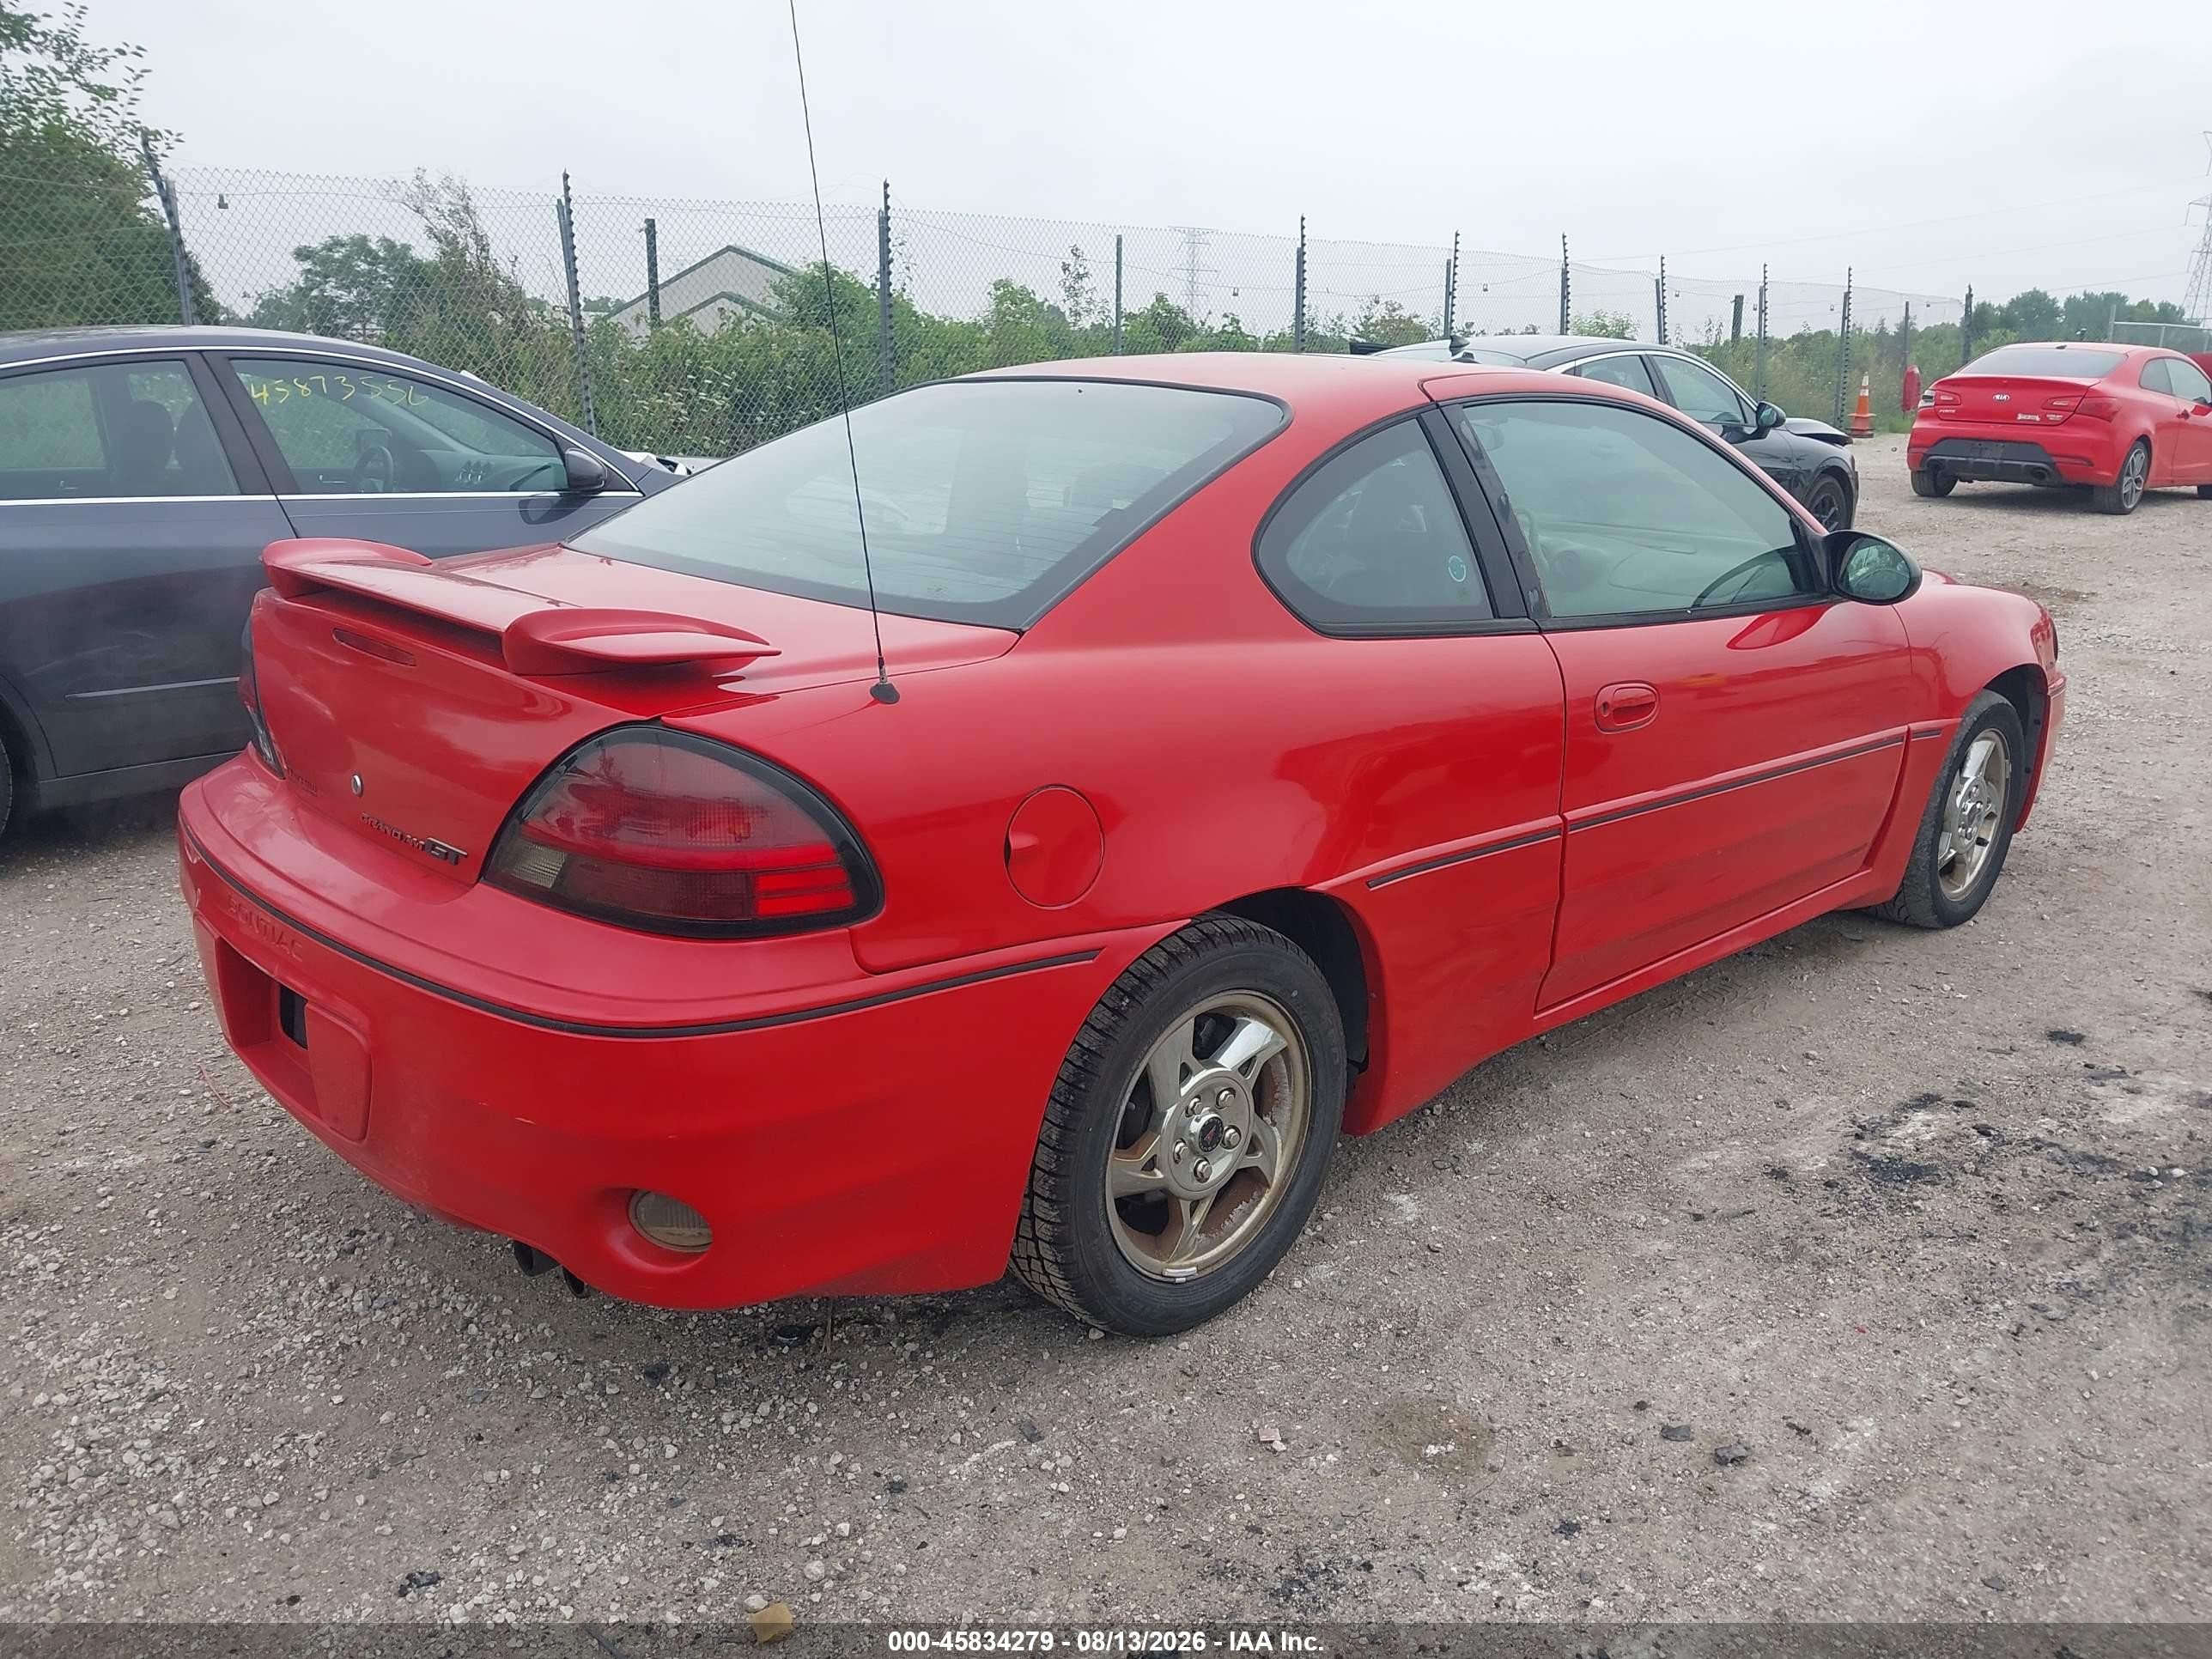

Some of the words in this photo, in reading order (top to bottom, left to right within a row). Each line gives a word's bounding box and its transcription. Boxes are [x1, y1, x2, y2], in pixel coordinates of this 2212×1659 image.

[251, 376, 429, 405] 45873556
[425, 837, 468, 866] GT
[227, 895, 303, 963] PONTIAC
